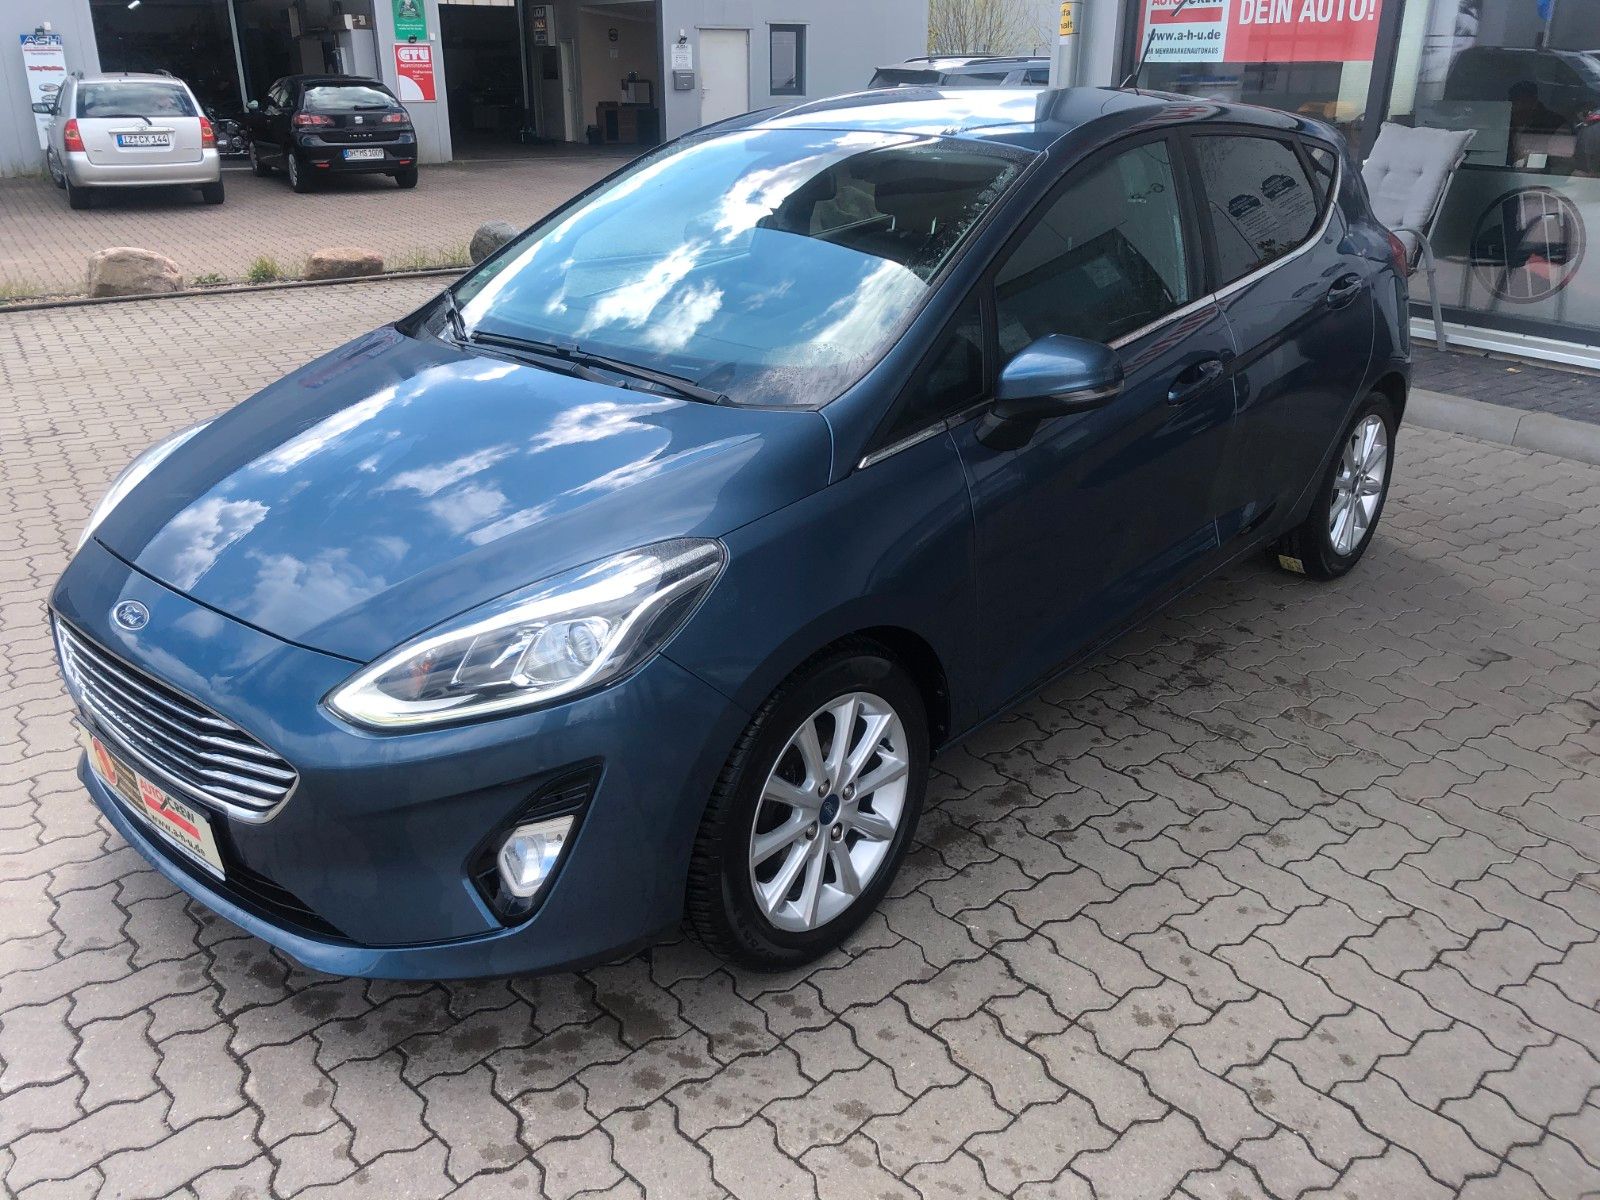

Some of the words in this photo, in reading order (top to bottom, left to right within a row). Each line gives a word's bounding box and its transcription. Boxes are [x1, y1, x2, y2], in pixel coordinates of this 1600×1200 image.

[1239, 0, 1294, 24] DEIN
[1298, 0, 1376, 23] AUTO!
[1148, 28, 1221, 41] www.a-h-u.de
[151, 134, 167, 143] 144
